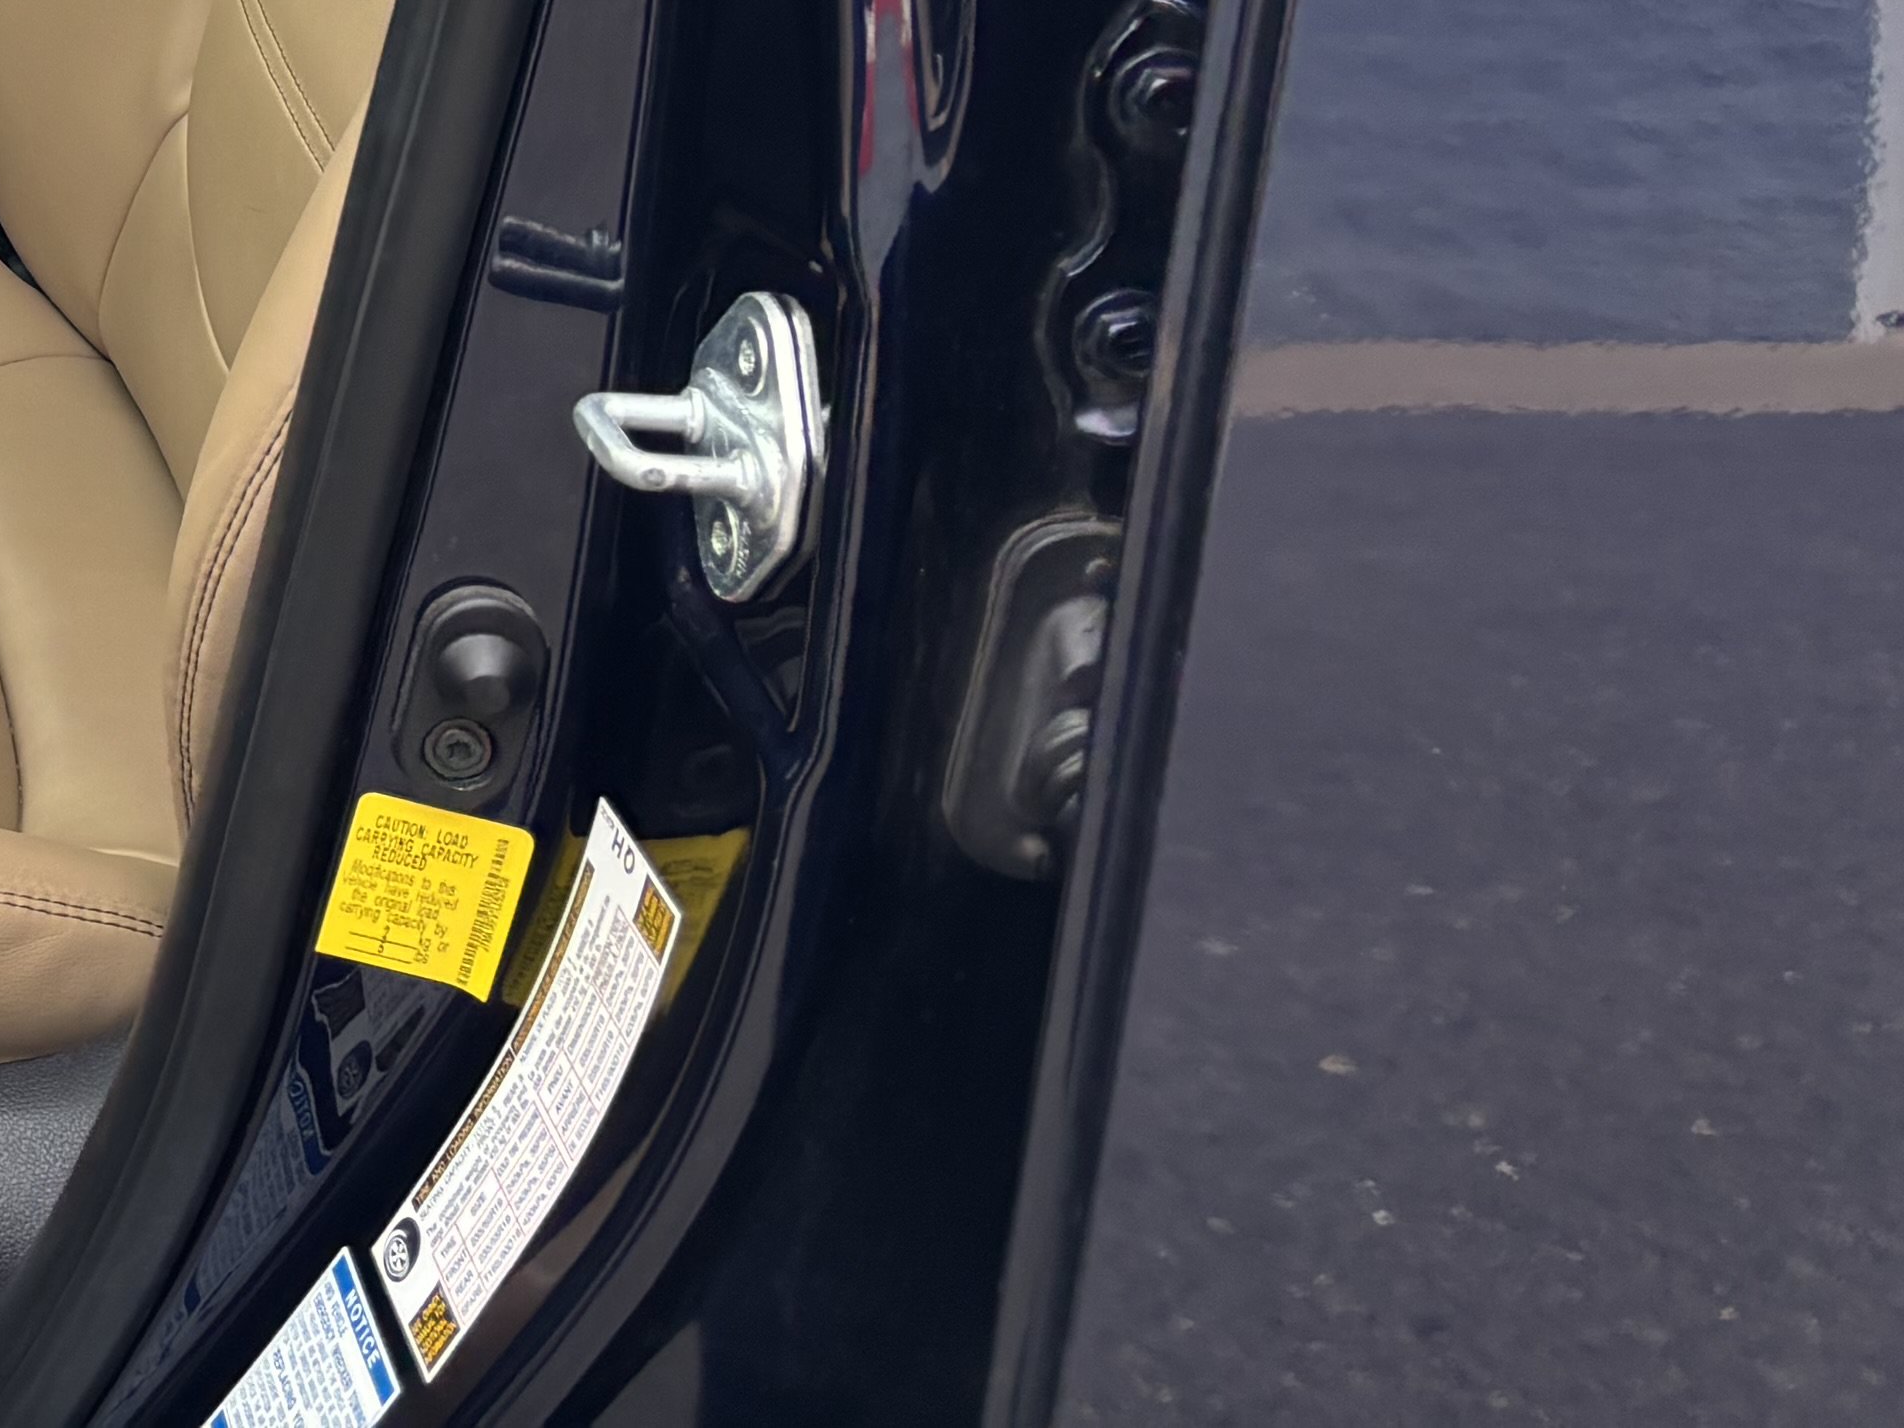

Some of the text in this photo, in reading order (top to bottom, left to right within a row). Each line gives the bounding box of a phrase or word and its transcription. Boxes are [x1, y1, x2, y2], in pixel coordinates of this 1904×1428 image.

[355, 826, 479, 870] CARRYING CAPACITY
[436, 828, 470, 849] LOAD
[371, 844, 428, 872] REDUCED
[344, 1288, 380, 1369] NOTICE
